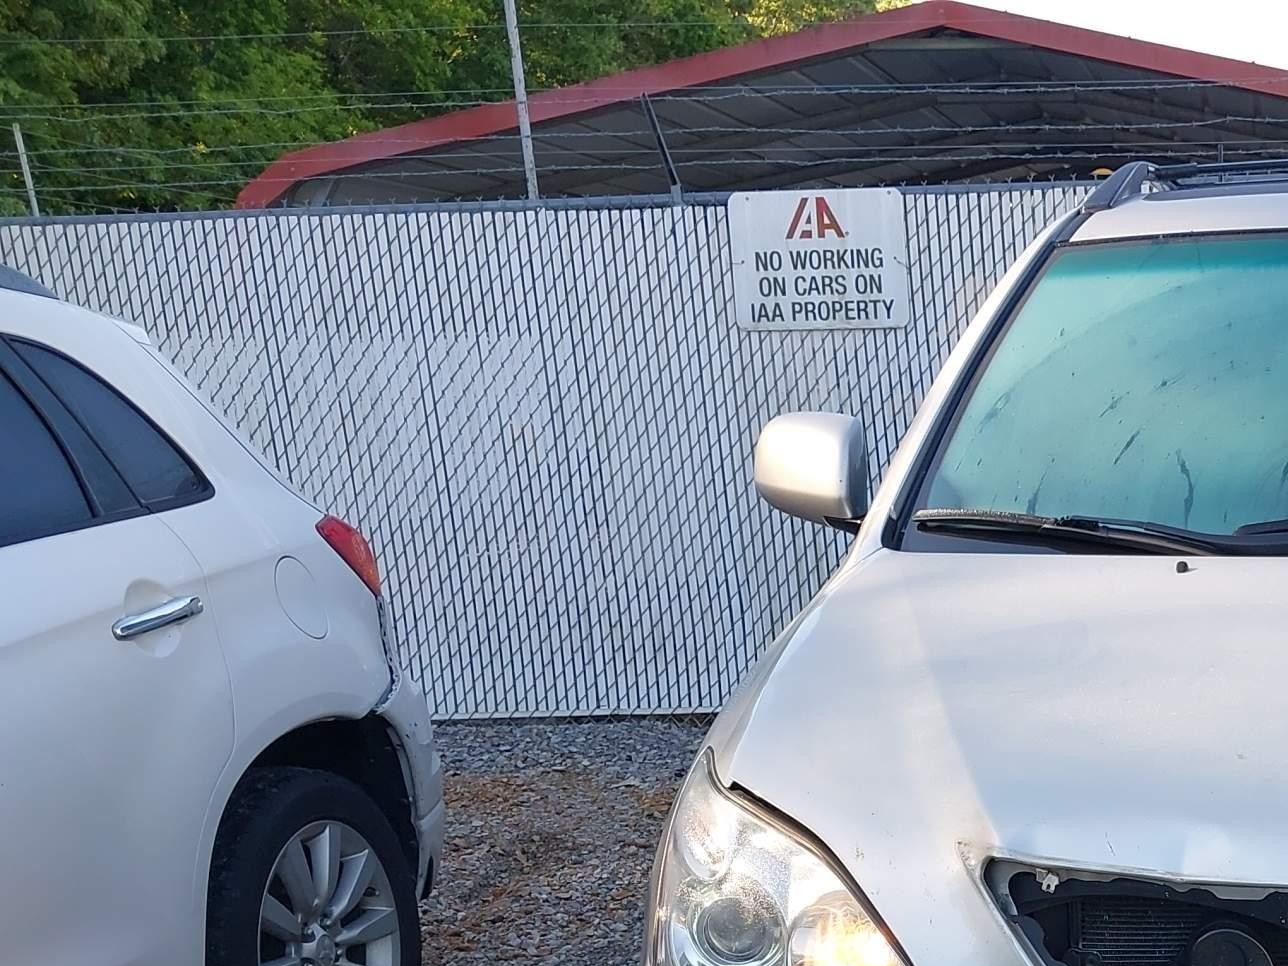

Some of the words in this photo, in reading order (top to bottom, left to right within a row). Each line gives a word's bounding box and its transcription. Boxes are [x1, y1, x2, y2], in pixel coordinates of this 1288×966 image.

[755, 250, 782, 272] NO
[789, 247, 884, 271] WORKING
[759, 276, 787, 297] ON
[794, 274, 848, 296] CARS
[855, 273, 883, 295] ON
[751, 301, 785, 323] IAA
[791, 298, 895, 322] PROPERTY
